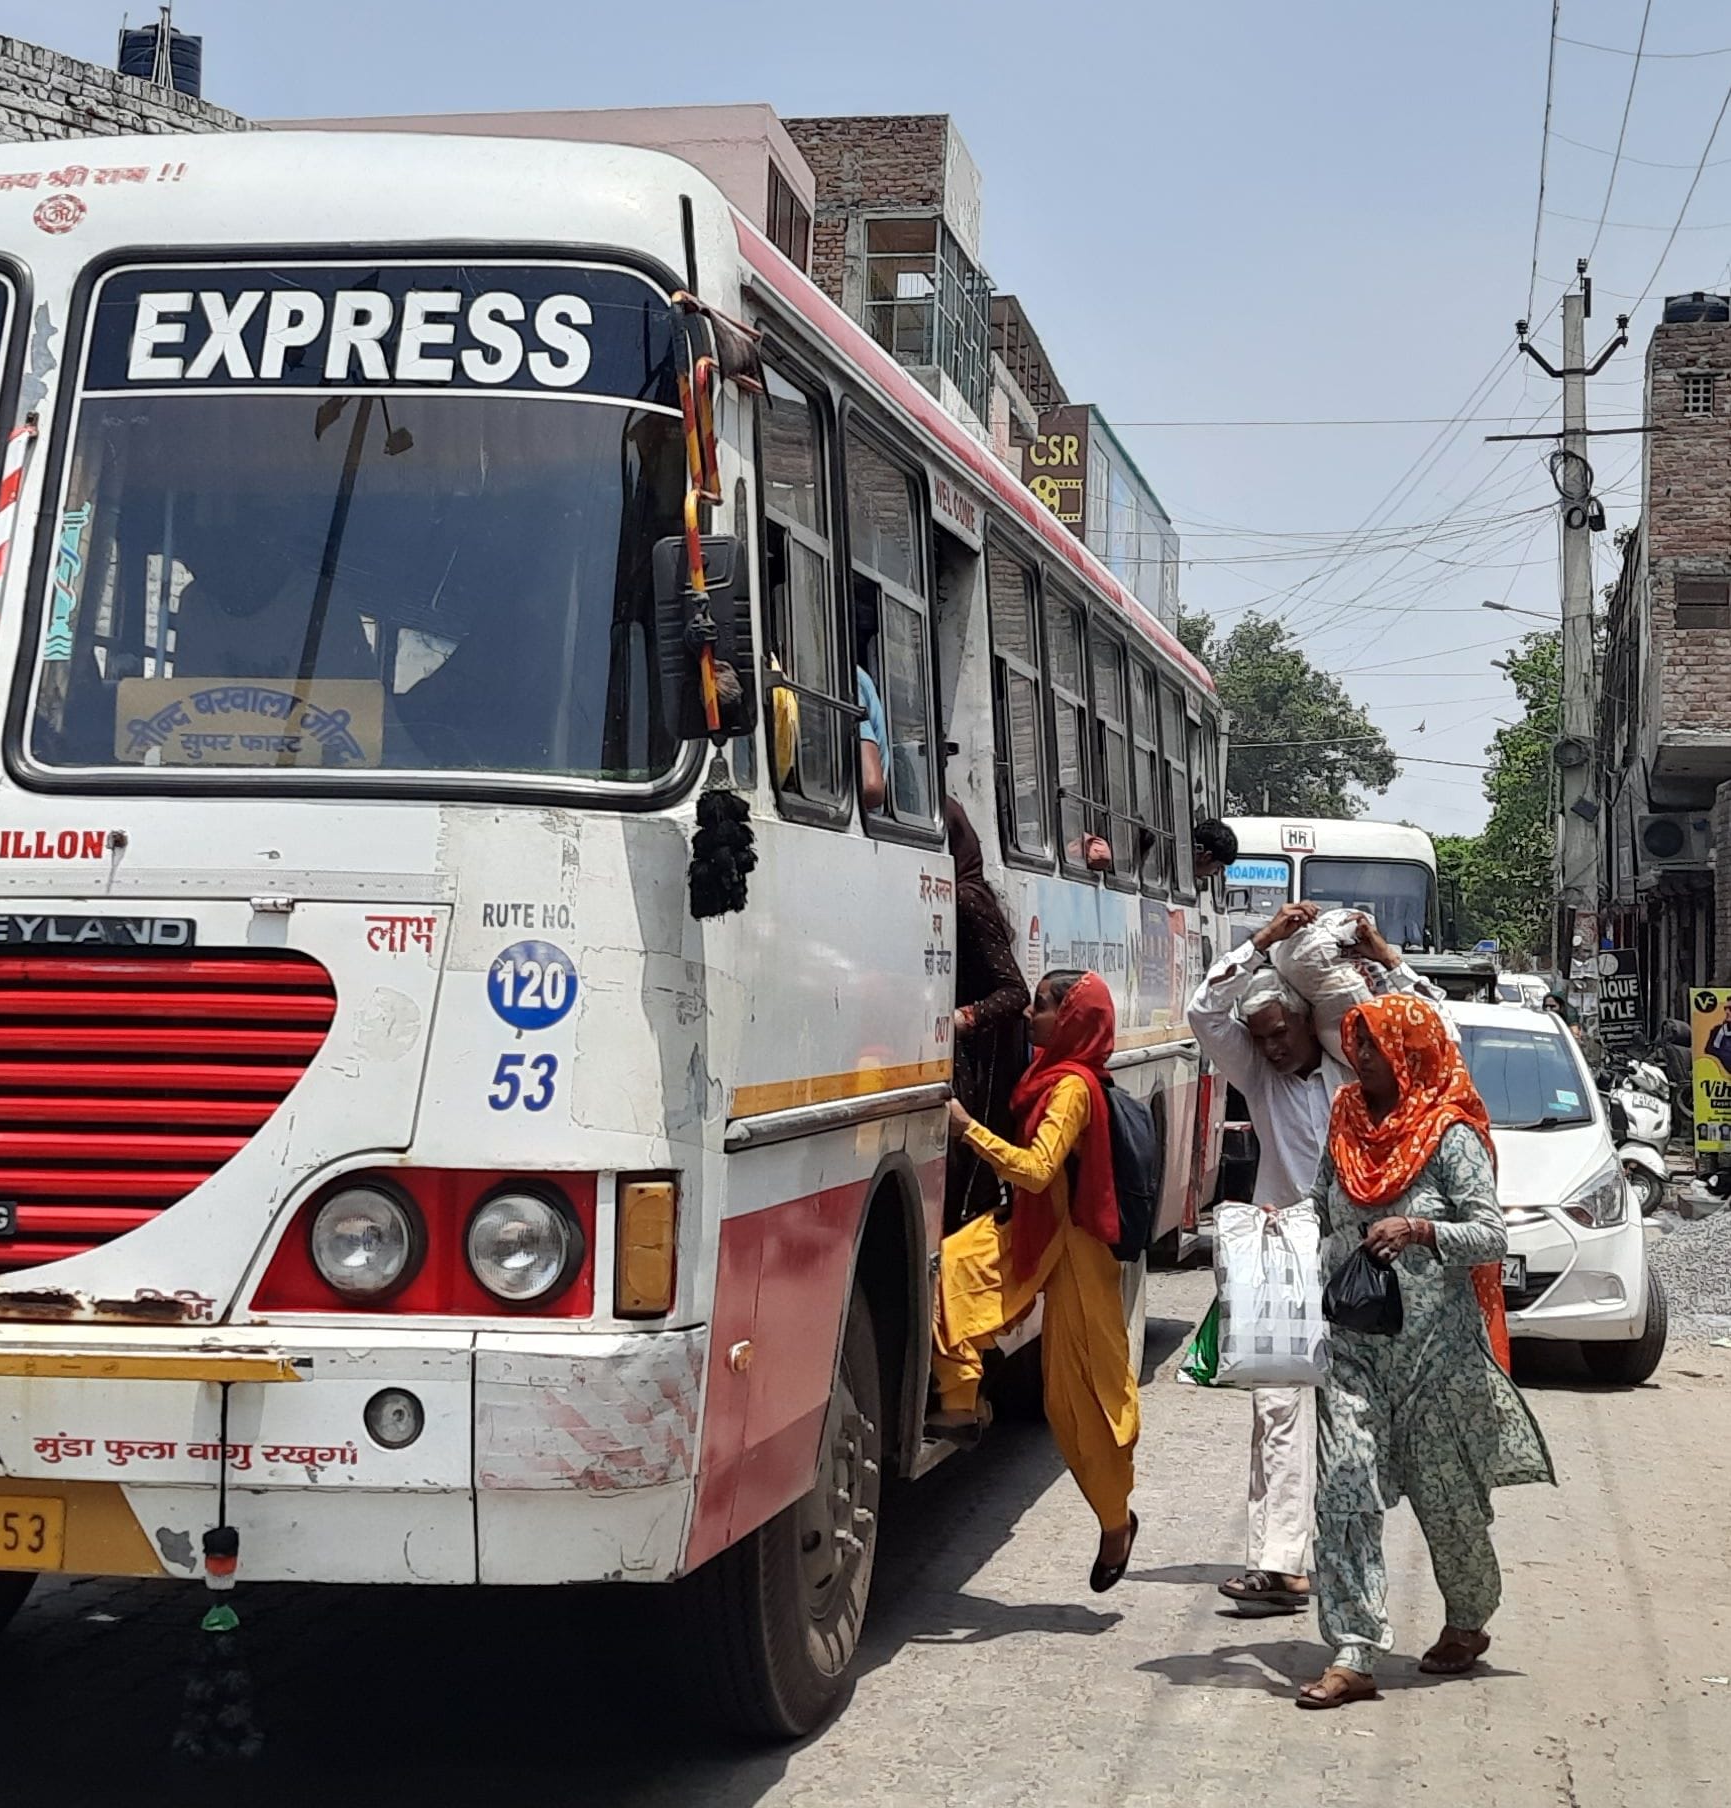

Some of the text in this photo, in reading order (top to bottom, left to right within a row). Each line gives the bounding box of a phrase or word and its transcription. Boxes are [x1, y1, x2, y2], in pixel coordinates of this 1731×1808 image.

[126, 290, 594, 388] EXPRESS
[1029, 435, 1080, 467] CSR
[1226, 865, 1288, 881] ROADWAYS
[482, 902, 535, 929] RUTE
[364, 915, 438, 957] लाभ
[496, 959, 567, 1010] 120
[1599, 978, 1639, 999] IQUE
[1599, 1000, 1636, 1020] TYLE
[487, 1053, 559, 1112] 53
[32, 1431, 96, 1463] मुंडा
[103, 1437, 178, 1466] फुला
